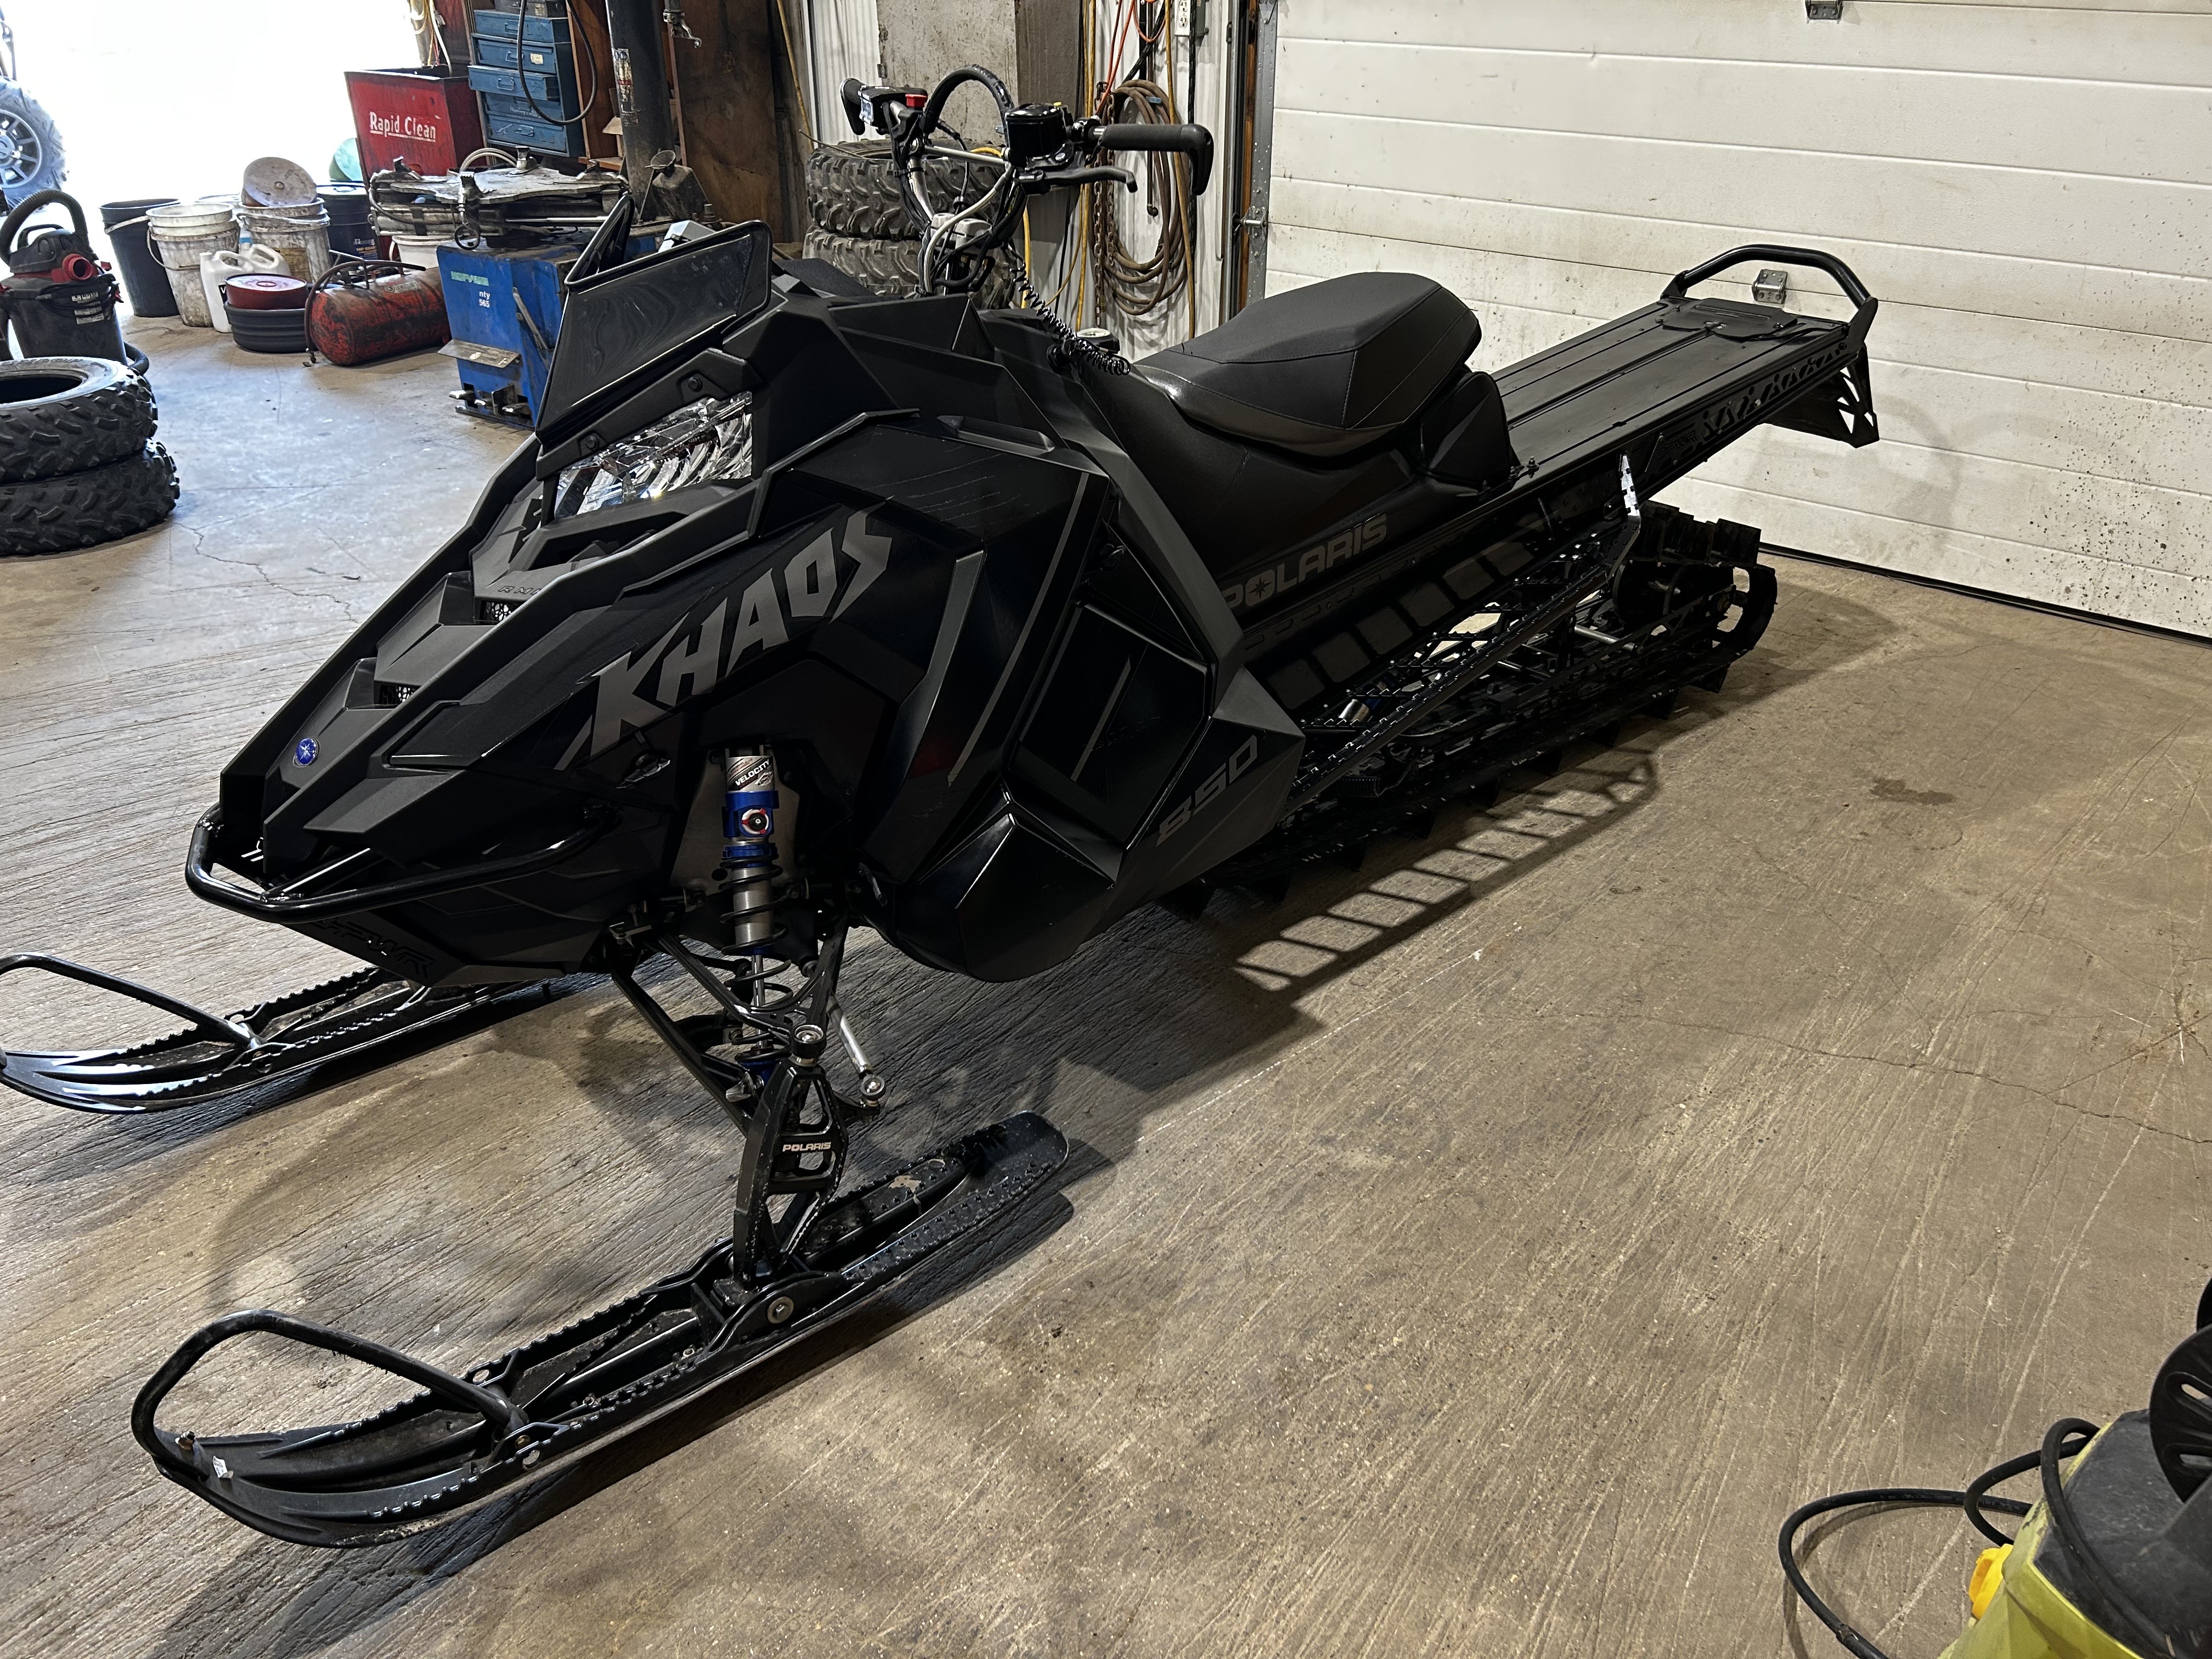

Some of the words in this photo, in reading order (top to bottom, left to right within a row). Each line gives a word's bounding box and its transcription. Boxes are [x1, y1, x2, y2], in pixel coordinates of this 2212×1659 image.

[370, 111, 399, 137] Rapid
[405, 116, 436, 139] Clean
[479, 291, 490, 300] nty
[1221, 511, 1387, 609] POLARIS
[590, 495, 894, 757] KHAOS
[735, 759, 770, 786] VELOCITY
[1155, 734, 1257, 848] 850
[782, 1141, 832, 1152] POLARIS
